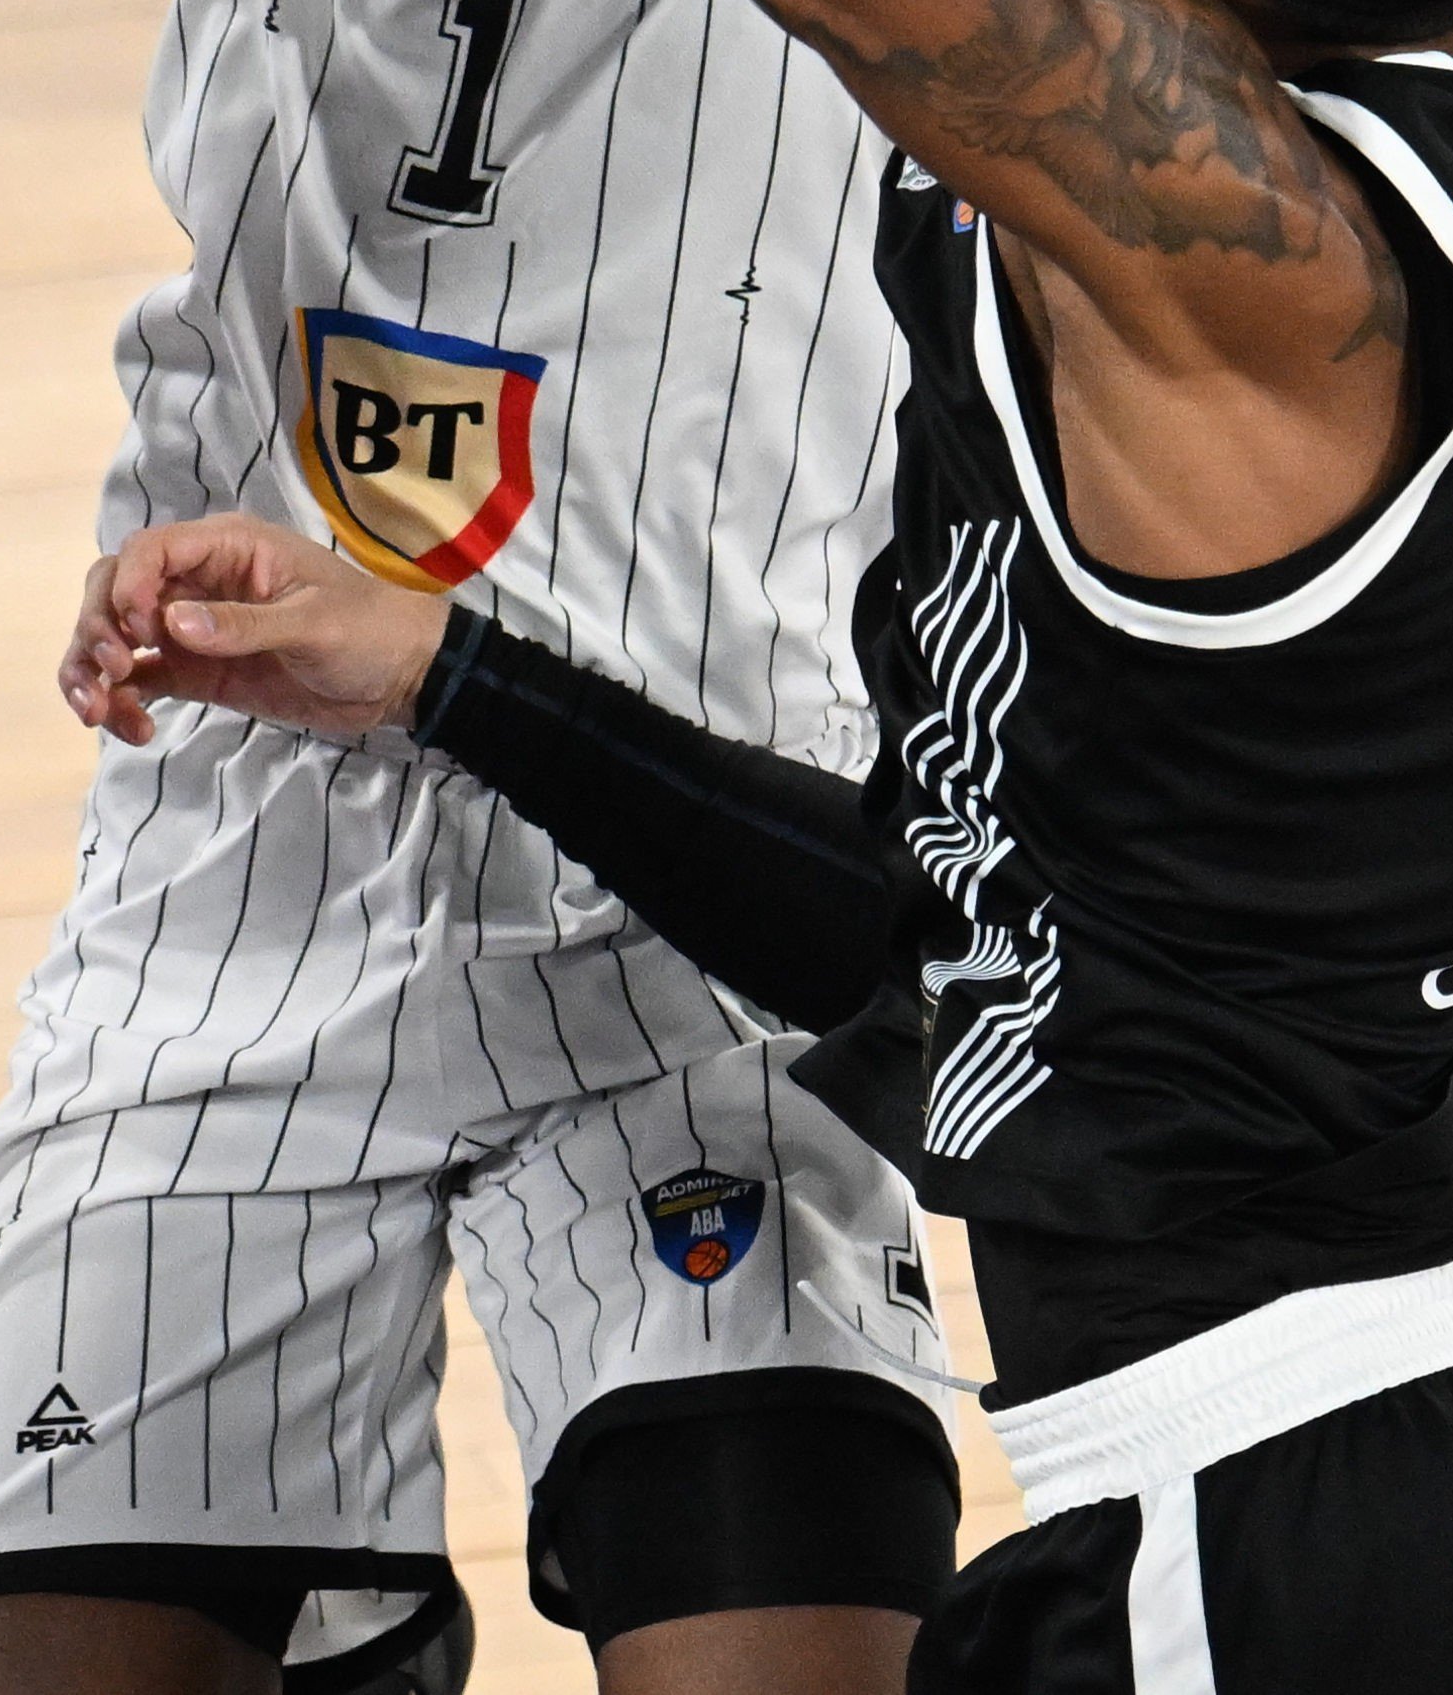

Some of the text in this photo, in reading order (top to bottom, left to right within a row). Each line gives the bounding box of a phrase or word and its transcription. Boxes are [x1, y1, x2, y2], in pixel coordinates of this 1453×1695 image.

[332, 378, 485, 482] BT
[690, 1205, 727, 1237] ABA
[16, 1423, 97, 1453] PEAK
